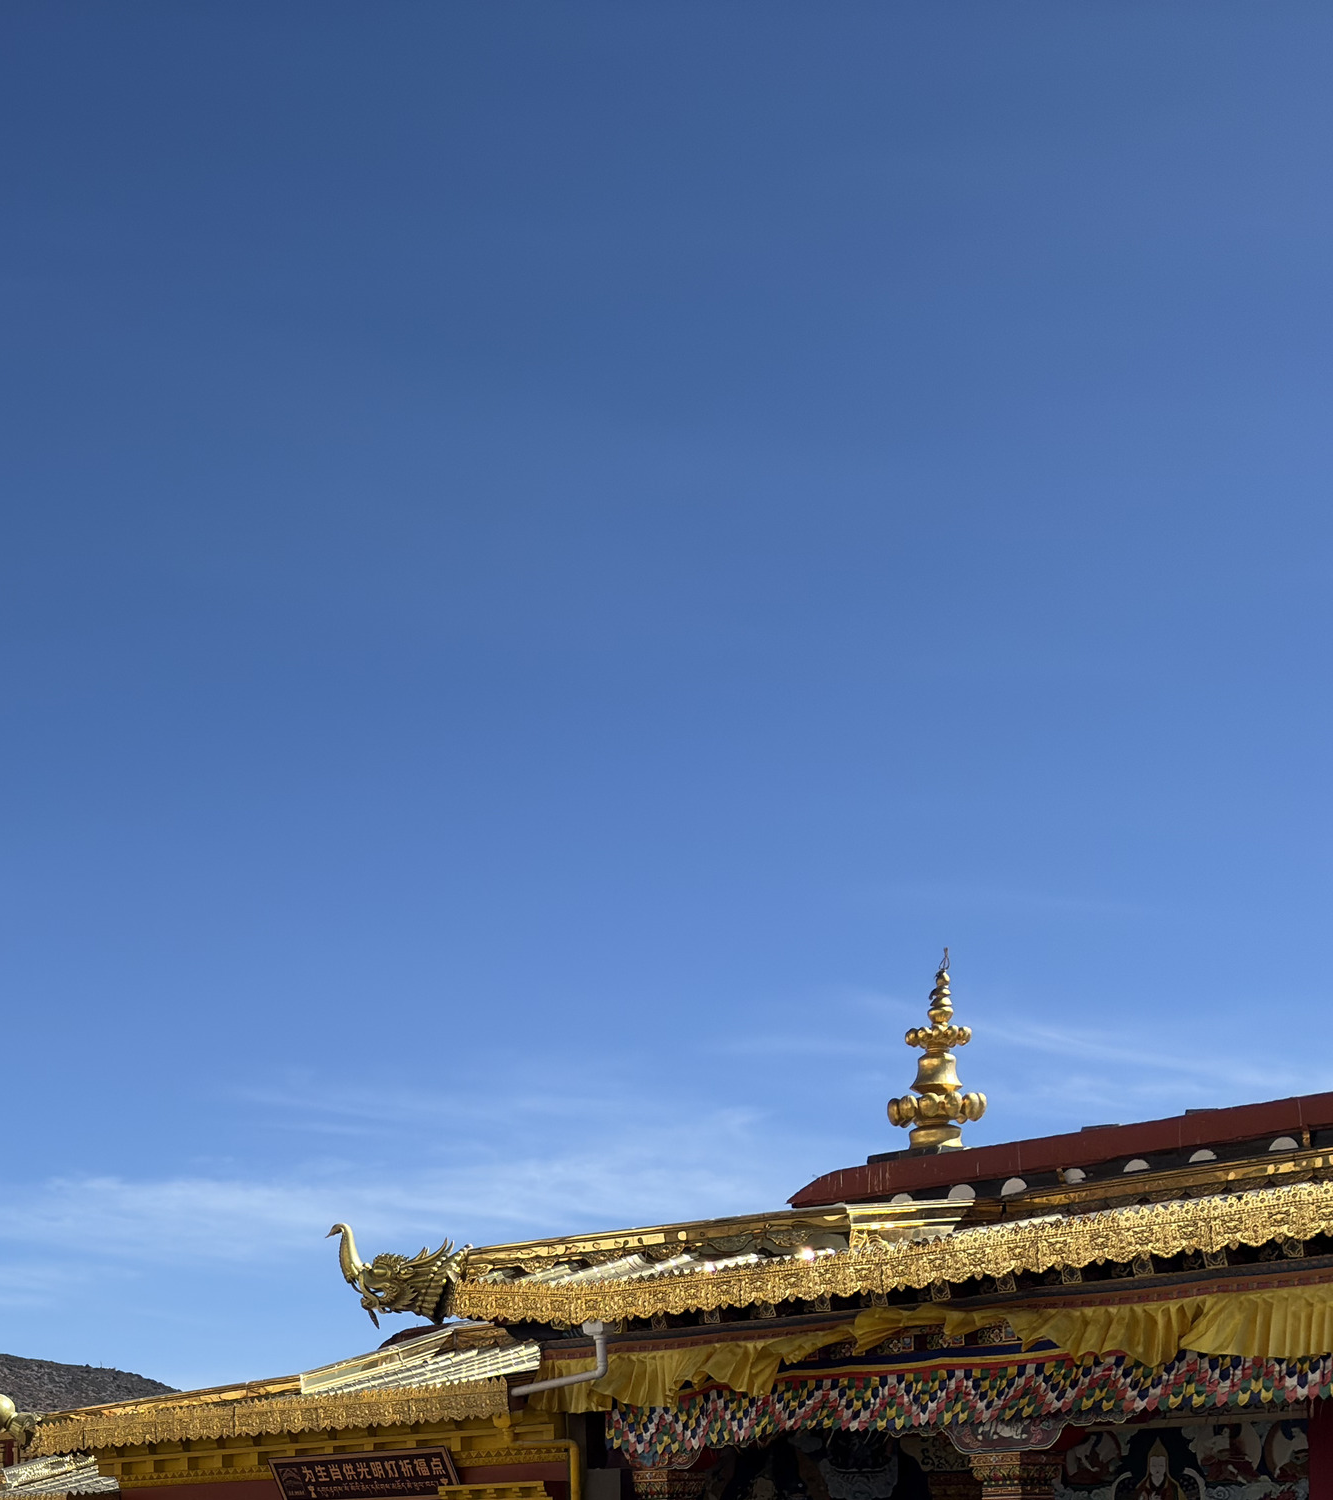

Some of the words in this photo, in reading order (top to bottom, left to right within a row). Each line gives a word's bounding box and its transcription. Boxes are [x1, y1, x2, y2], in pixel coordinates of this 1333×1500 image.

[301, 1456, 447, 1484] 为生肖供光明灯祈福点
